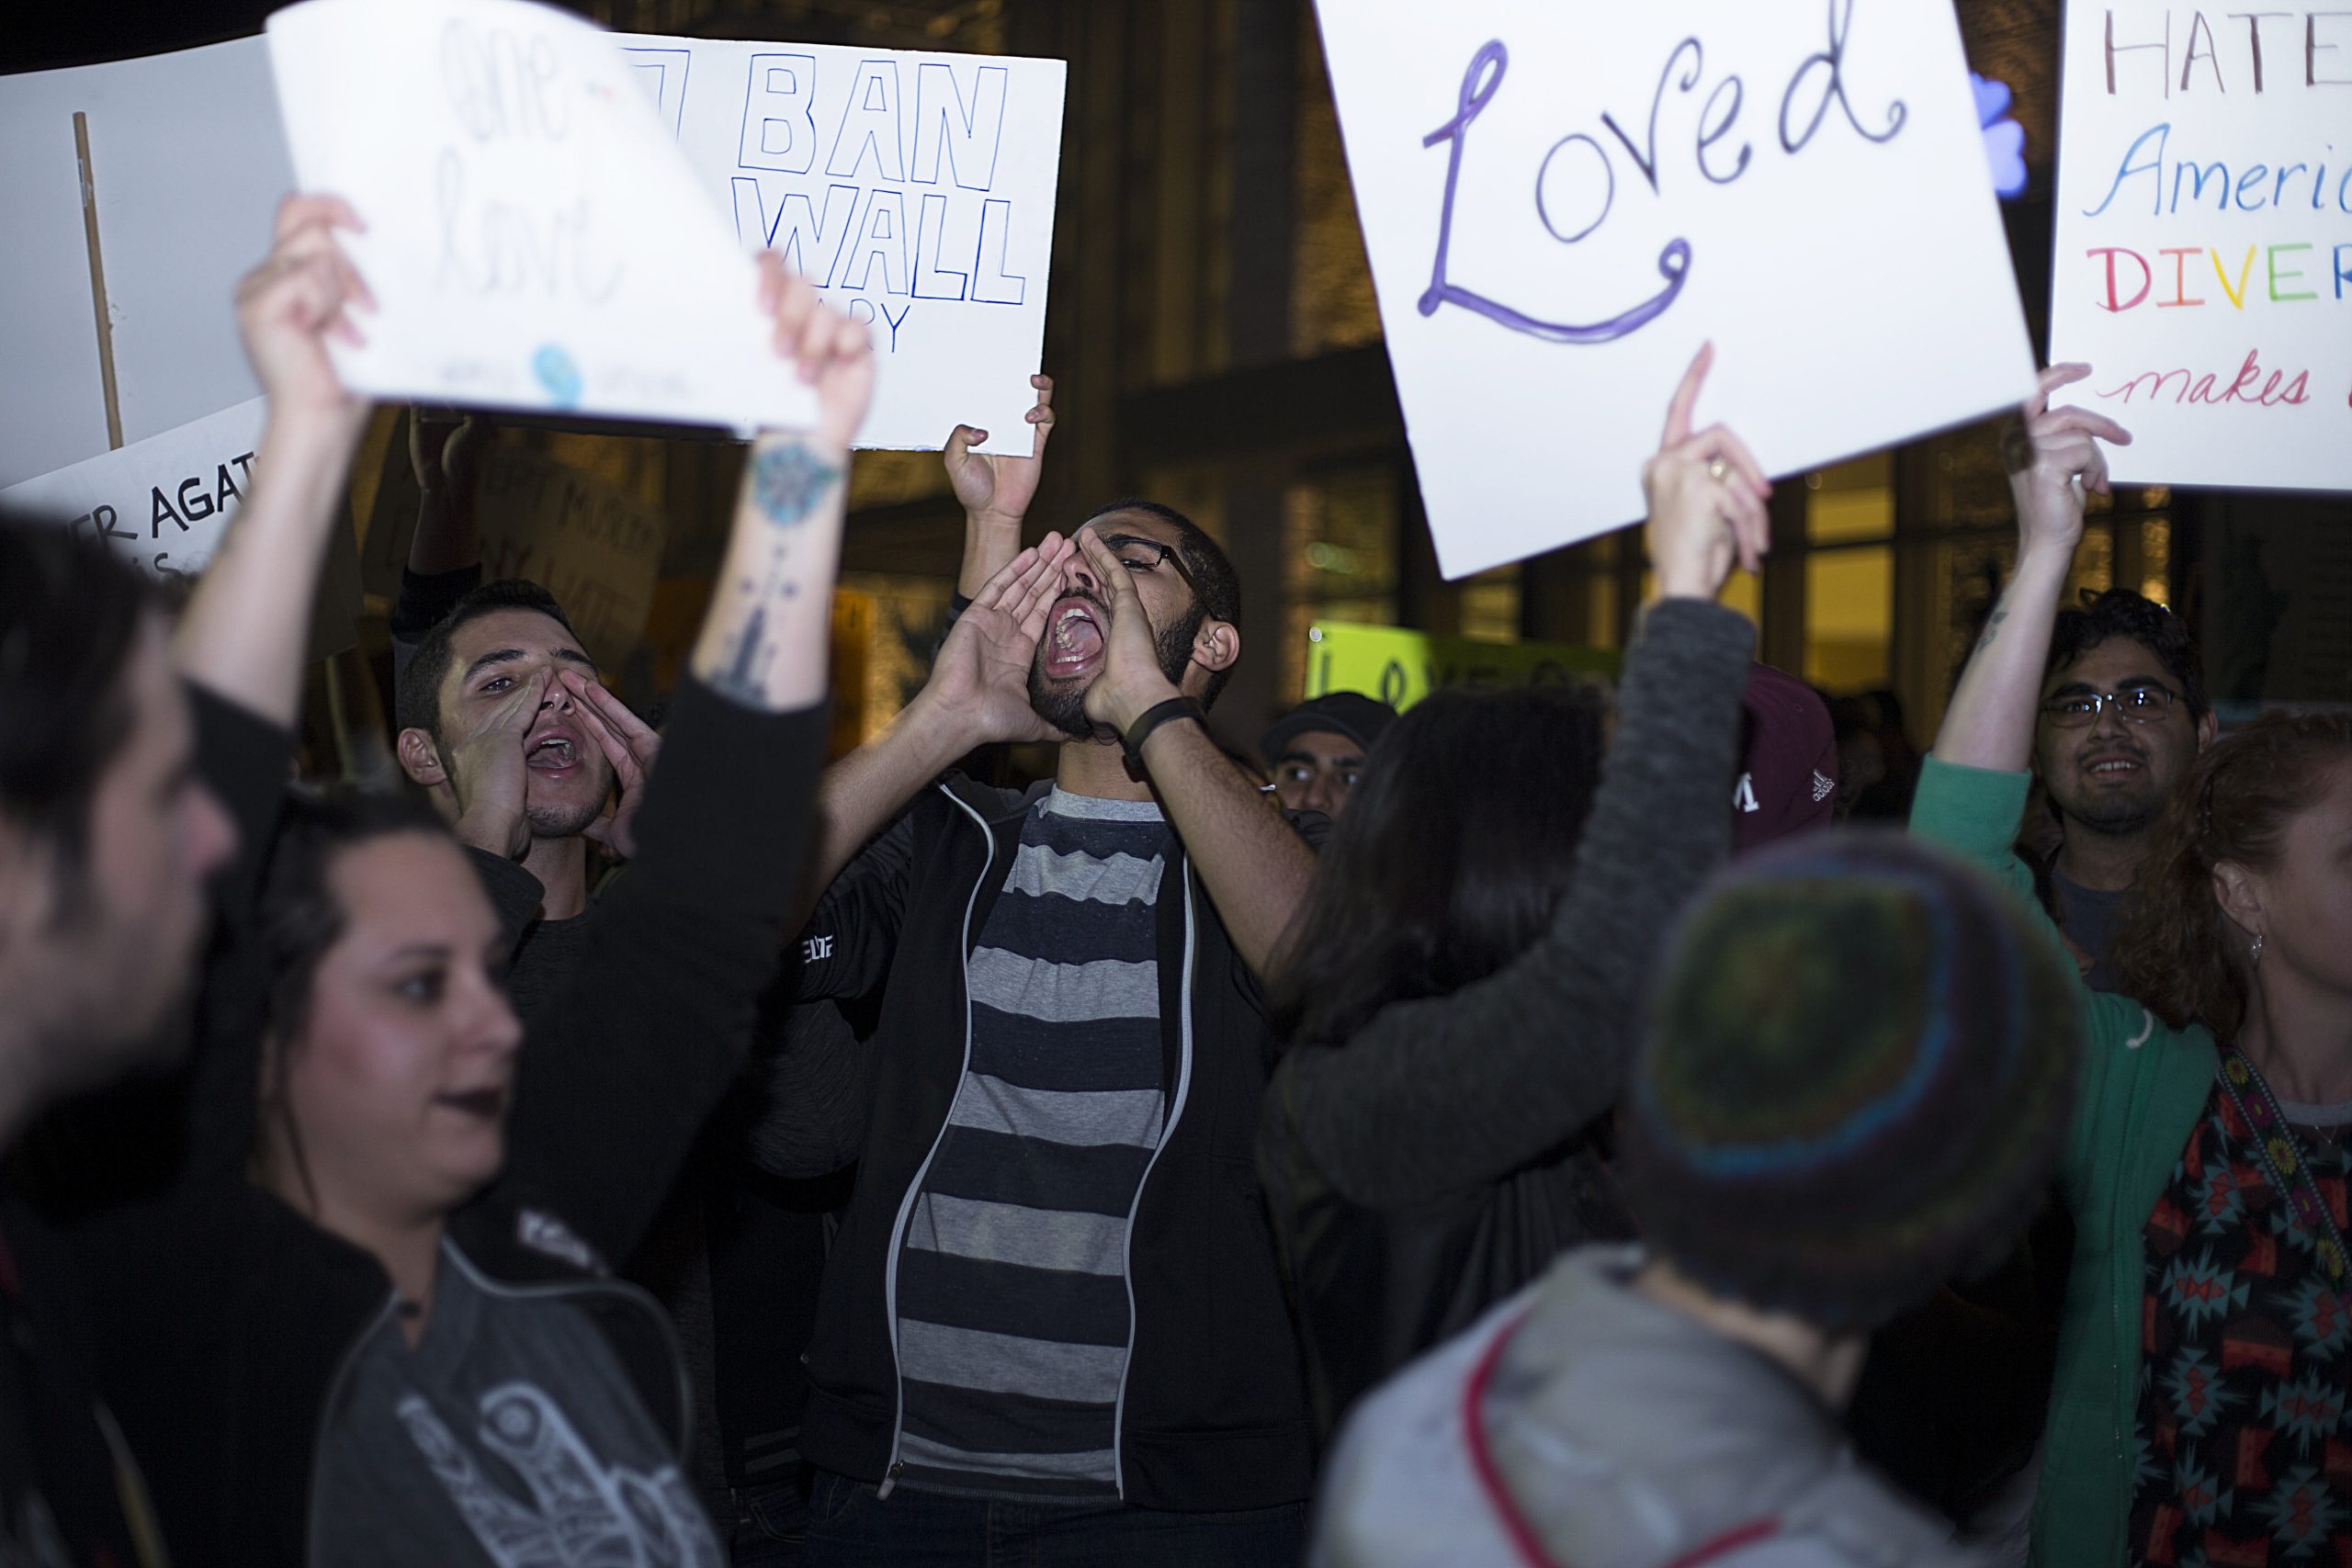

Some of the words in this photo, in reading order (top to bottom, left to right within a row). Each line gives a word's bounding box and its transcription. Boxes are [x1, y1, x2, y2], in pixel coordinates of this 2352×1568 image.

[2105, 8, 2352, 100] HATE
[738, 51, 1009, 192] BAN
[1418, 0, 1907, 344] Loved
[730, 176, 1026, 305] WALL
[2096, 348, 2311, 406] makes
[1813, 778, 1836, 802] adidas
